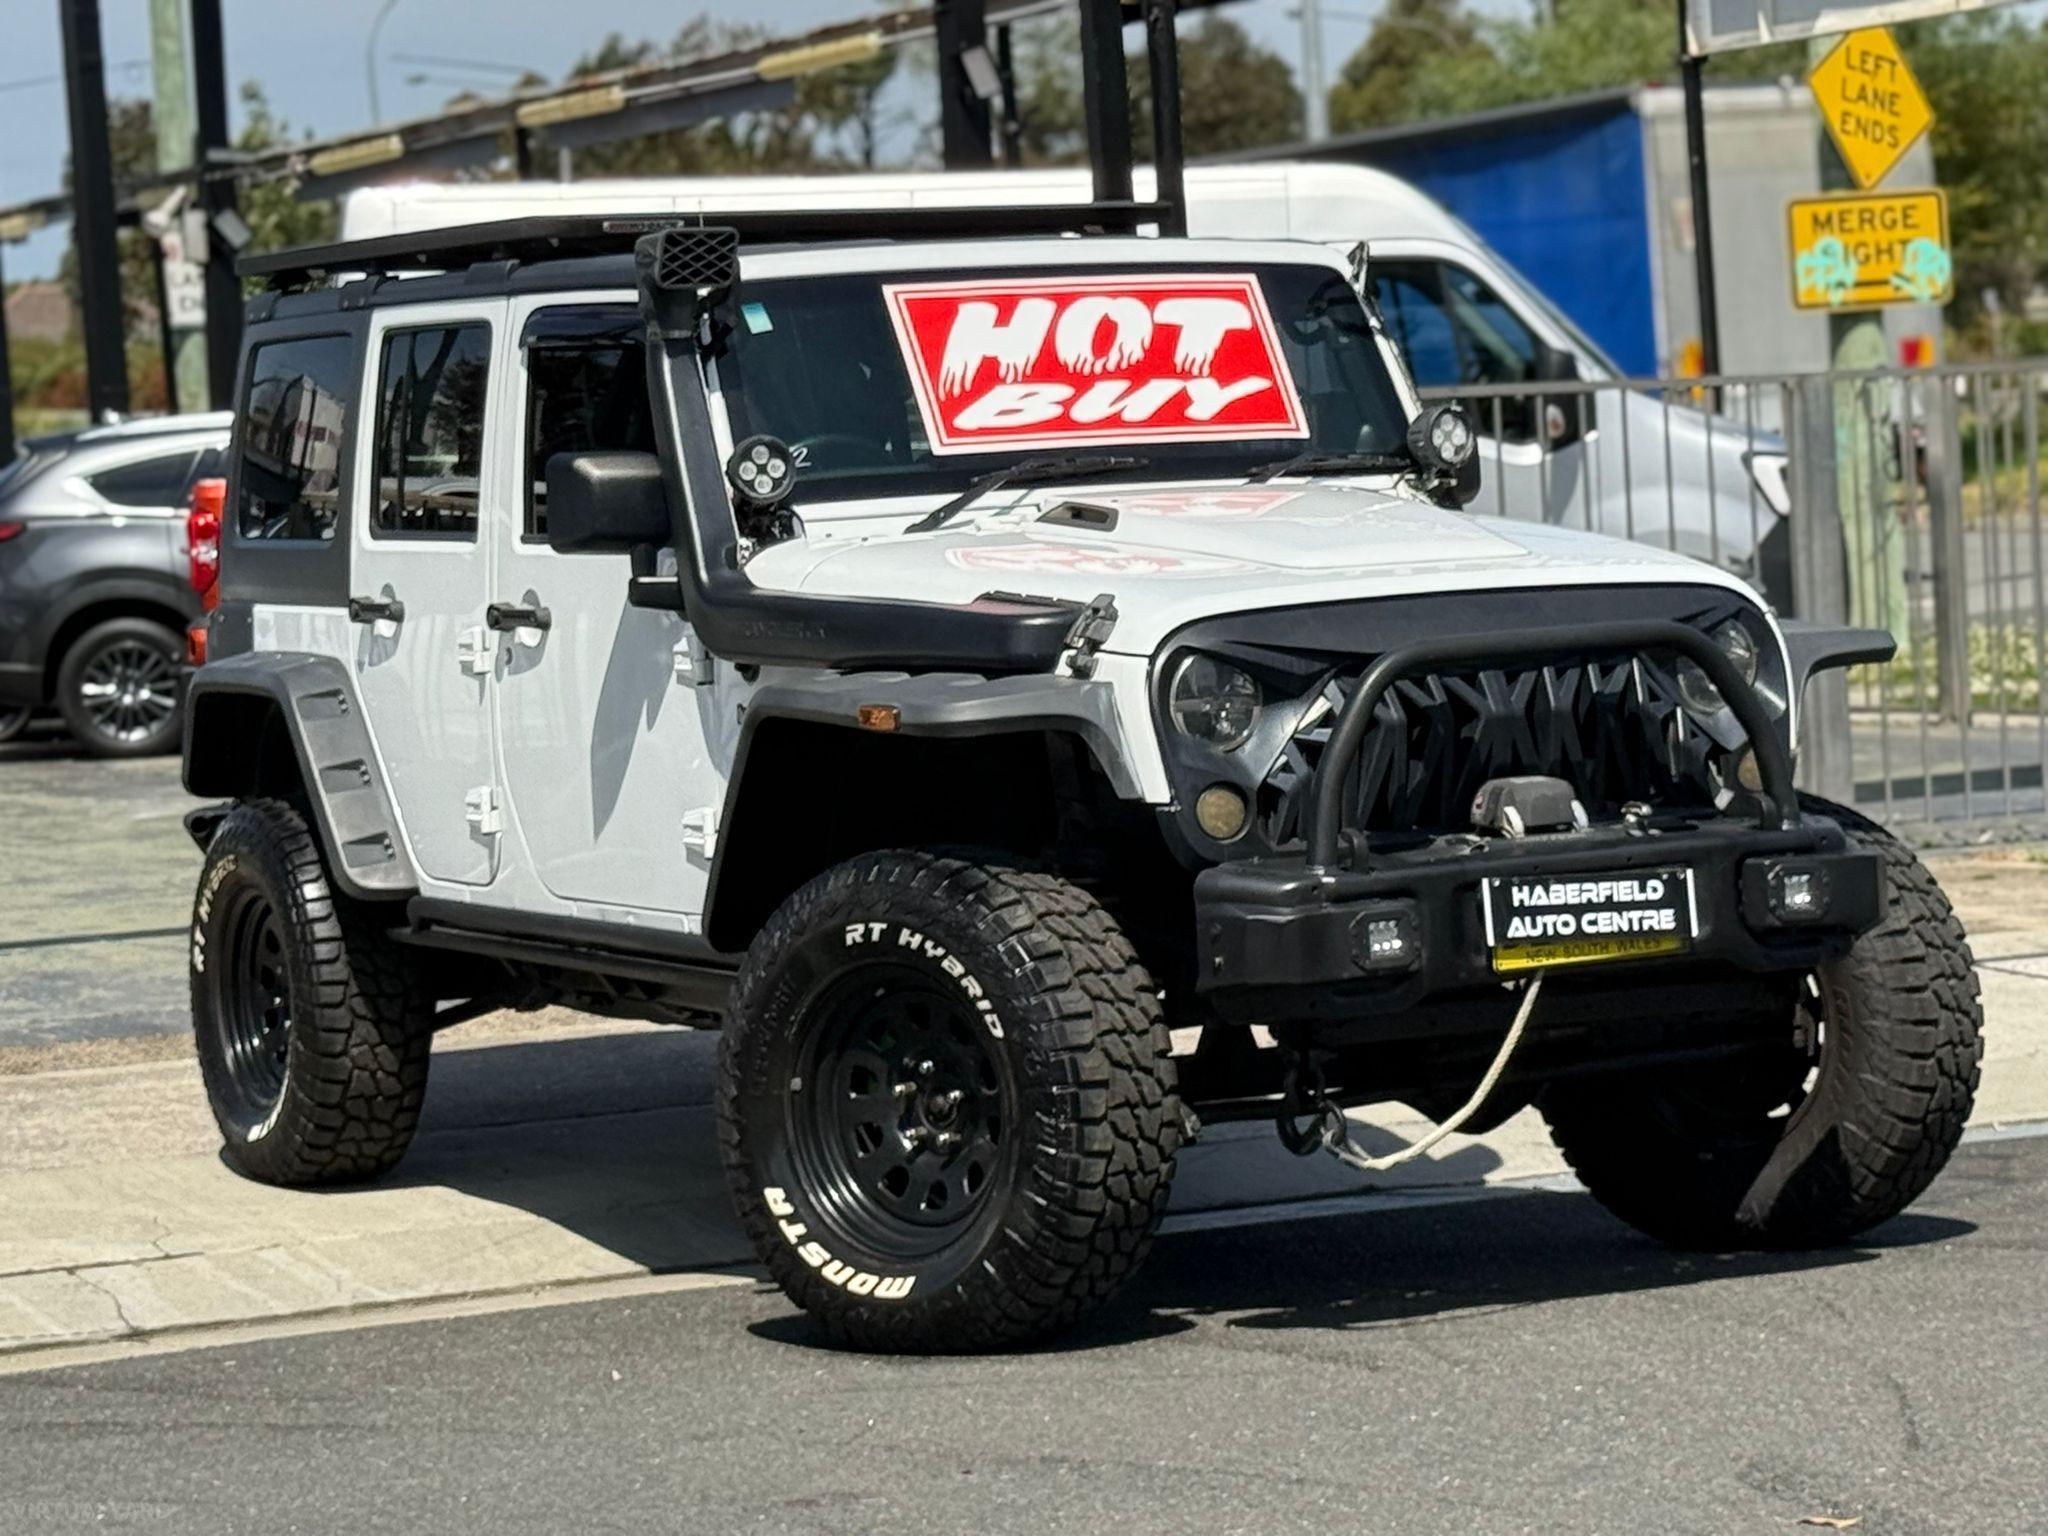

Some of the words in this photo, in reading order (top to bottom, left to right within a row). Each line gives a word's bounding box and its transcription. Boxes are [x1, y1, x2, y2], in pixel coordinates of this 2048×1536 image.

[1846, 46, 1899, 82] LEFT
[1841, 79, 1901, 117] LANE
[1840, 112, 1900, 149] ENDS
[1812, 204, 1919, 234] MERGE
[1818, 239, 1912, 267] IGHT
[938, 296, 1254, 402] HOT
[952, 376, 1273, 431] BUY
[1511, 879, 1665, 907] HABERFIELD
[1507, 913, 1577, 939] AUTO
[1581, 908, 1676, 934] CENTRE
[1526, 950, 1556, 963] NEW
[1563, 944, 1609, 957] SOUTH
[1617, 938, 1661, 952] WALES
[845, 922, 888, 947] RT
[897, 927, 1005, 1039] HYBRID
